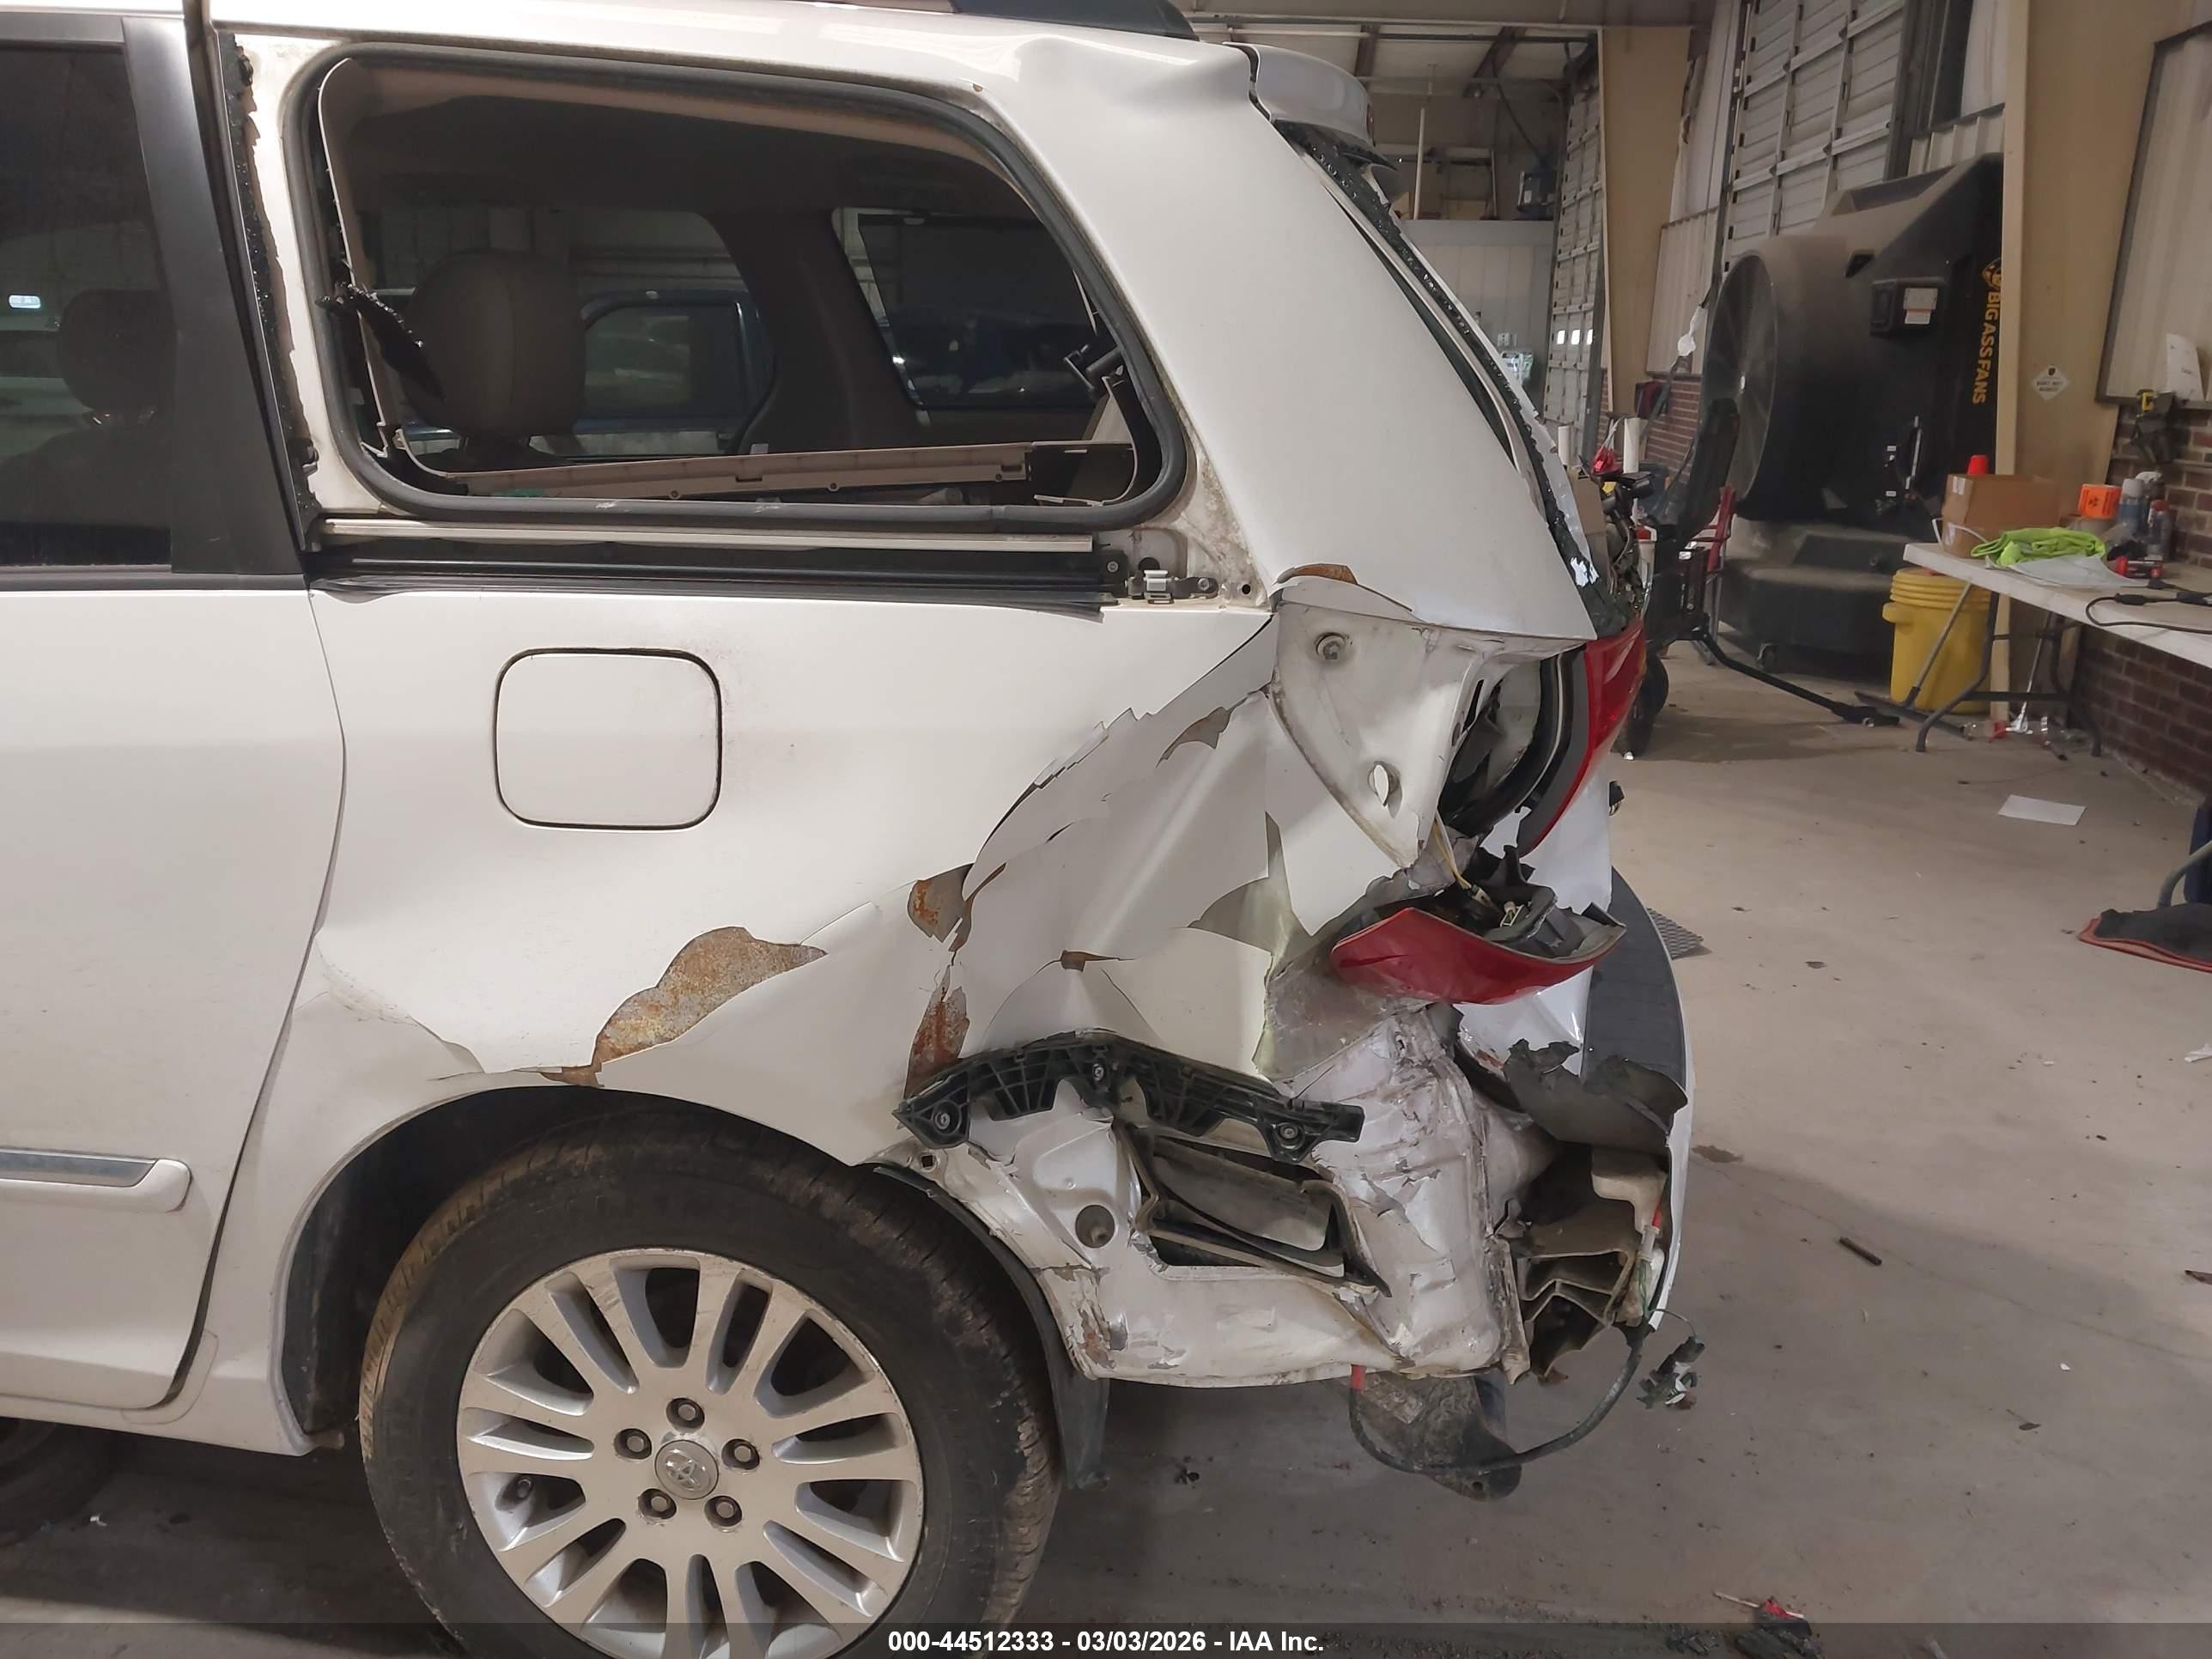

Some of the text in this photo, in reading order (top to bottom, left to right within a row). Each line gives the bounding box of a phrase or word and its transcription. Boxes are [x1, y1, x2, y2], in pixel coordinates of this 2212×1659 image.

[1972, 291, 2001, 404] BIG ASS FANS
